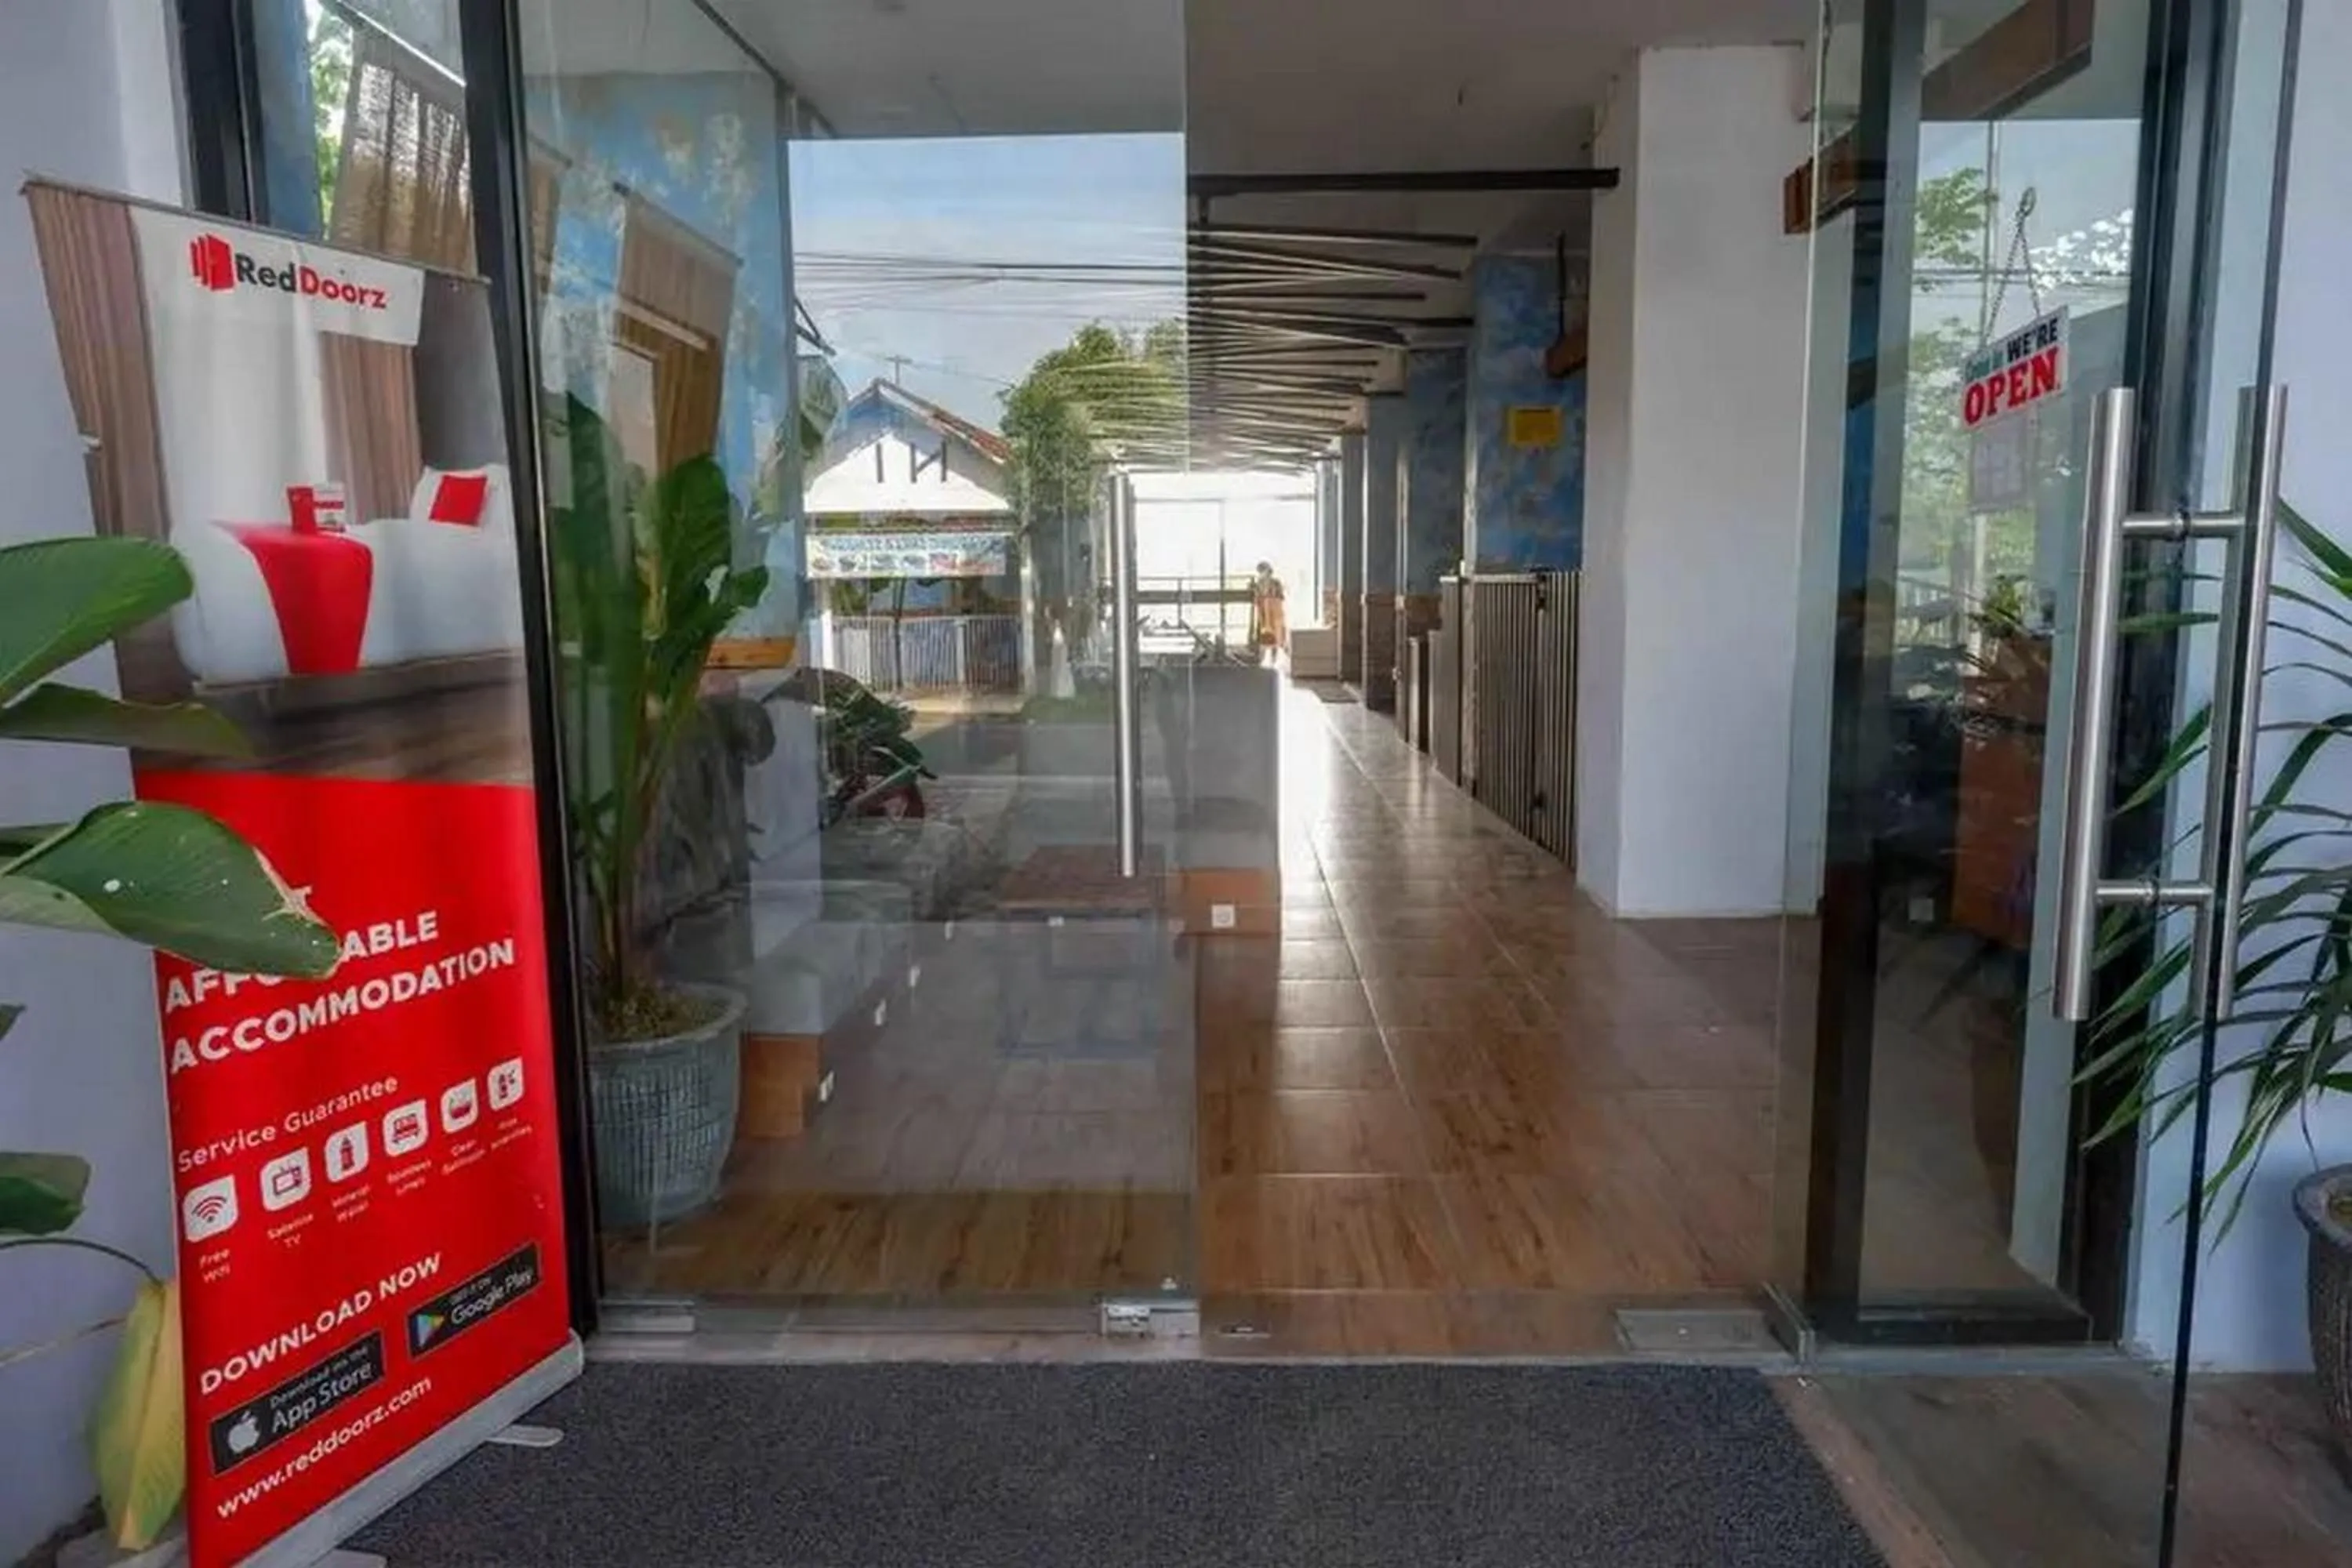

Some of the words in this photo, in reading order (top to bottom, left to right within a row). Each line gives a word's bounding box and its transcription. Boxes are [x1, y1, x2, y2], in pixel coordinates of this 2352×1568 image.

[234, 253, 387, 309] RedDoorz
[2007, 318, 2058, 362] WE'RE
[1964, 345, 2060, 425] OPEN
[170, 938, 514, 1074] ACCOMMODATION
[178, 1124, 276, 1173] Service
[284, 1076, 398, 1133] Guarantee
[199, 1289, 372, 1396] DOWNLOAD
[378, 1252, 441, 1301] NOW
[451, 1284, 506, 1325] Google
[504, 1266, 535, 1294] Play
[272, 1396, 317, 1434] App
[318, 1361, 374, 1406] Store
[216, 1376, 432, 1519] www.reddoorz.com
